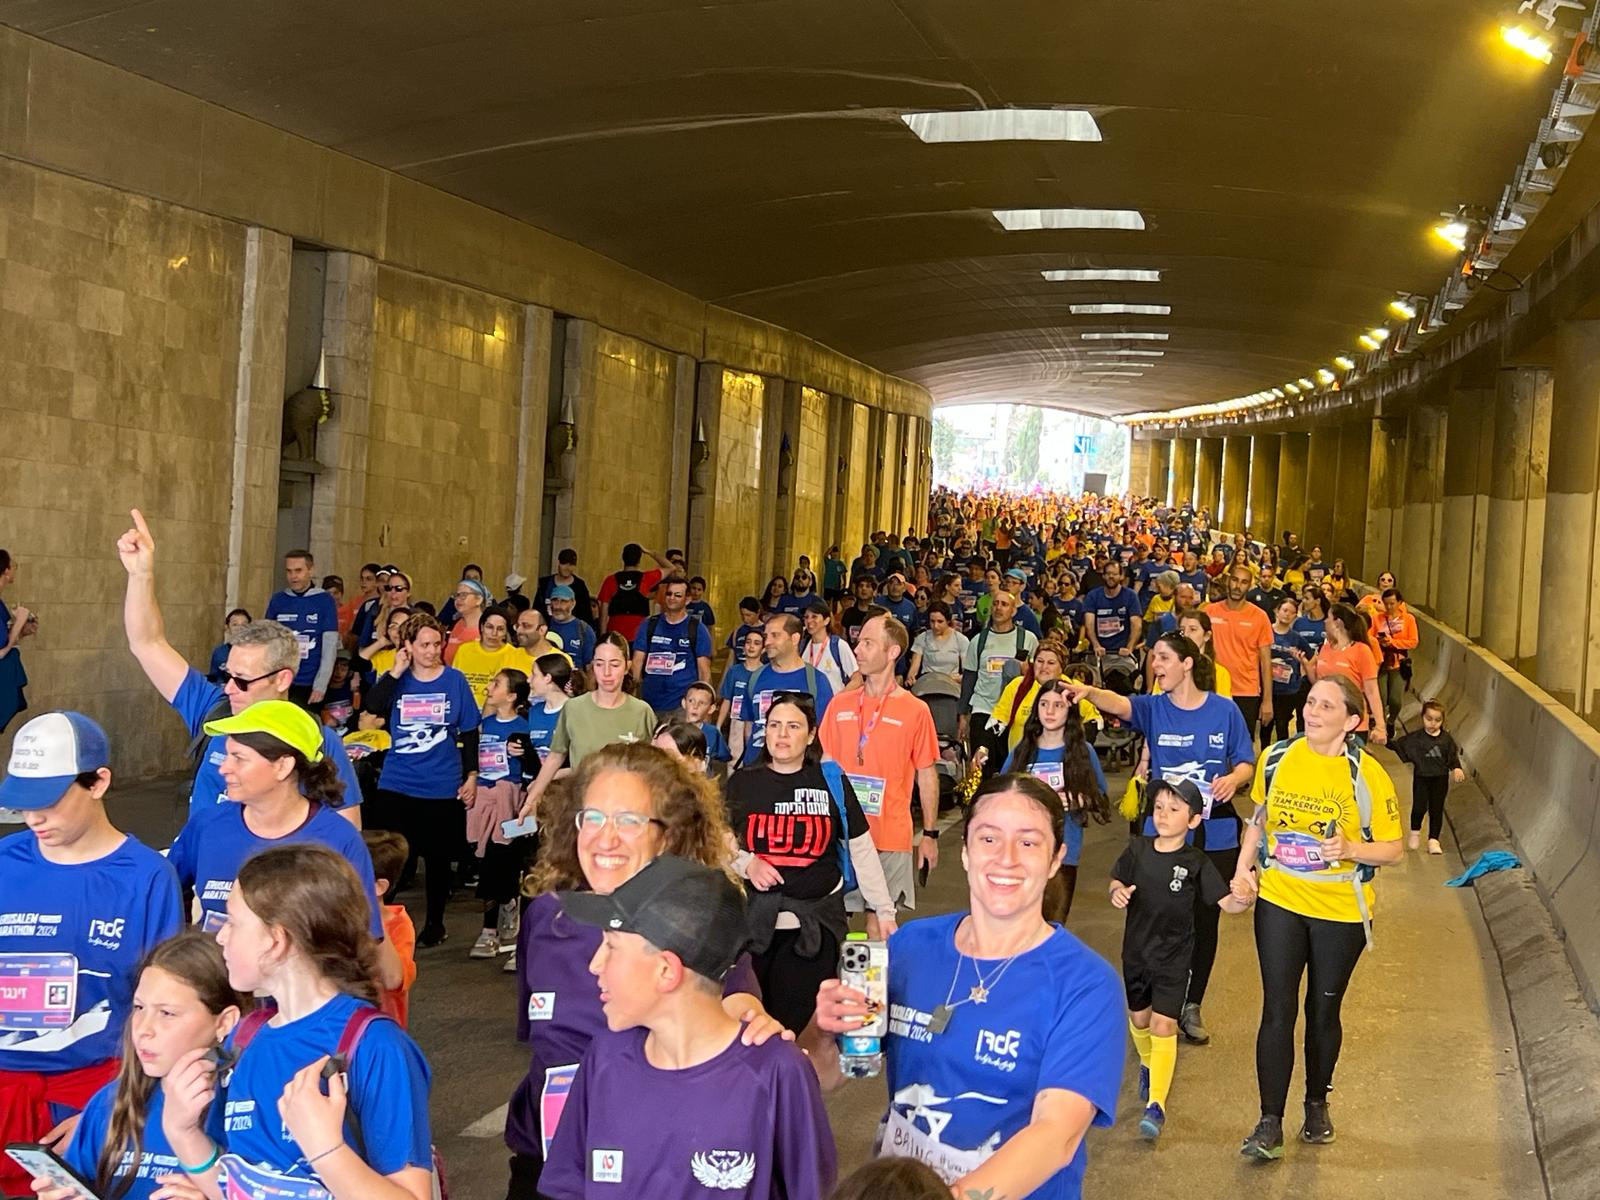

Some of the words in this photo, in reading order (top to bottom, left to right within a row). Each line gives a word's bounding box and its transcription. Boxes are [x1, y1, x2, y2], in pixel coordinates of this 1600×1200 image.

[794, 788, 829, 802] מחזירים
[774, 801, 806, 815] הביתה
[806, 802, 831, 816] אותם
[1273, 796, 1292, 804] TEAM
[1293, 800, 1322, 811] KEREN
[36, 925, 58, 937] 2024
[910, 1024, 934, 1044] 2024
[231, 1115, 253, 1132] 2024
